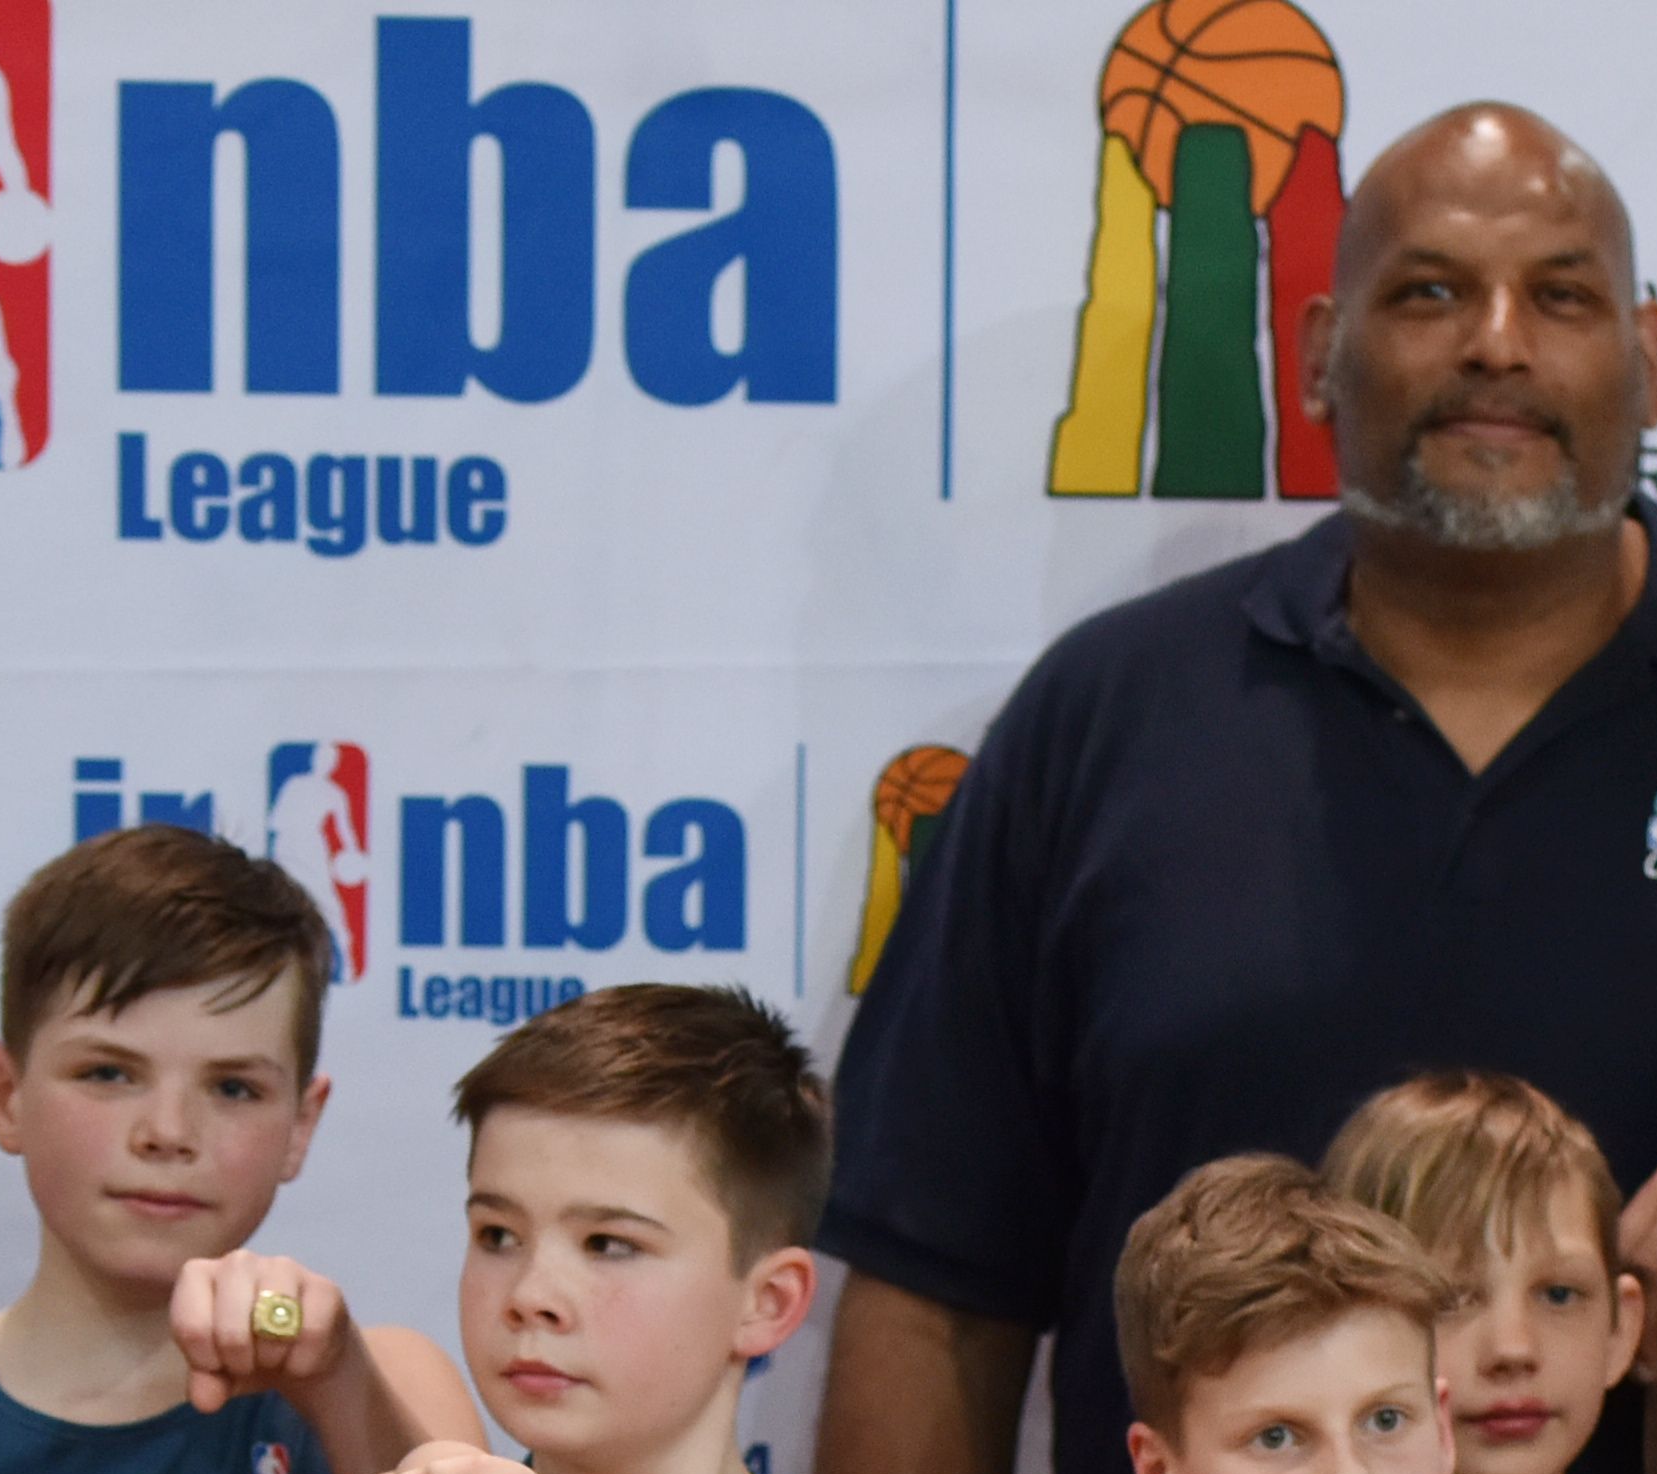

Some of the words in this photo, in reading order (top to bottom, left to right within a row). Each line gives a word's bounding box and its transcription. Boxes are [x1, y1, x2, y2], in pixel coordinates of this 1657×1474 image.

[117, 16, 838, 407] nba
[117, 432, 507, 557] League
[399, 764, 746, 952] nba
